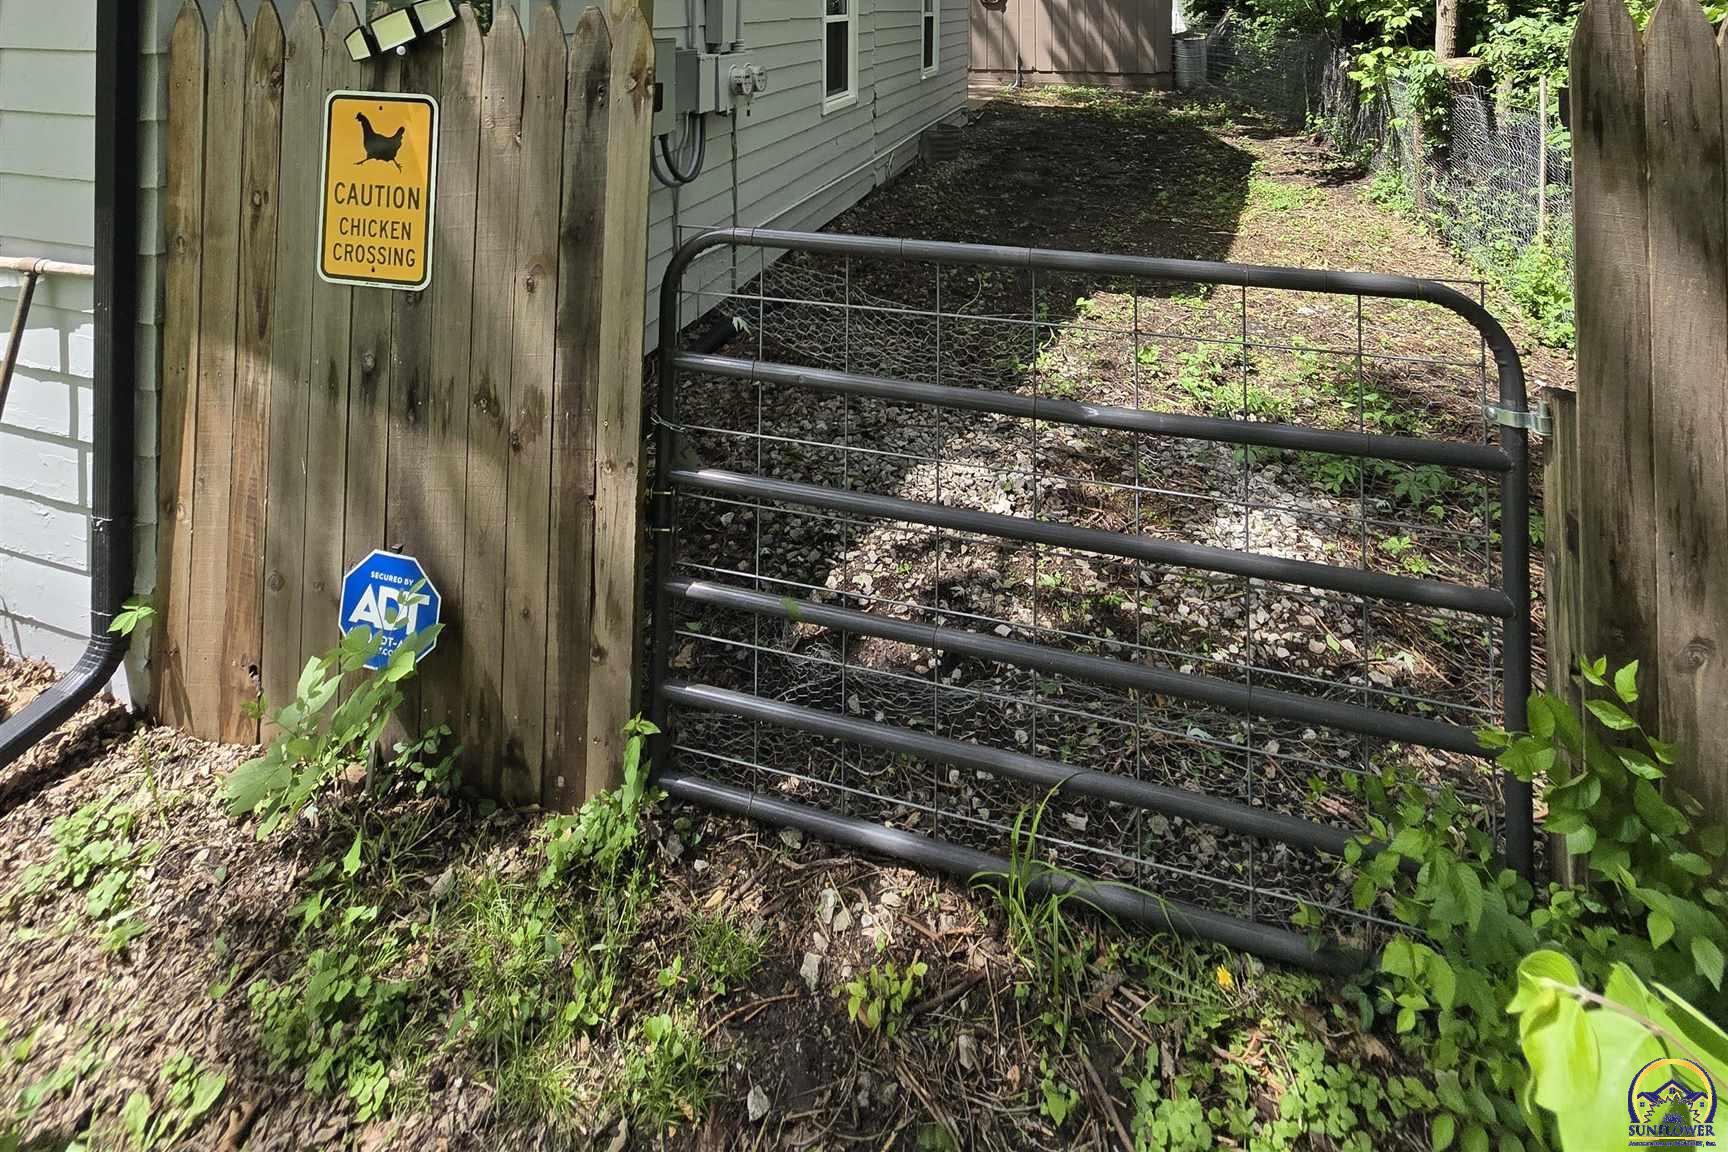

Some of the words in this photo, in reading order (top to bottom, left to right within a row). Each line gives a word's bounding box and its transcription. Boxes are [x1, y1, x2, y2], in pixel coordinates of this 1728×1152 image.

[334, 181, 420, 210] CAUTION
[339, 217, 412, 240] CHICKEN
[333, 243, 416, 267] CROSSING
[370, 570, 402, 583] SECURED
[404, 578, 414, 586] BY
[348, 583, 430, 635] ADT
